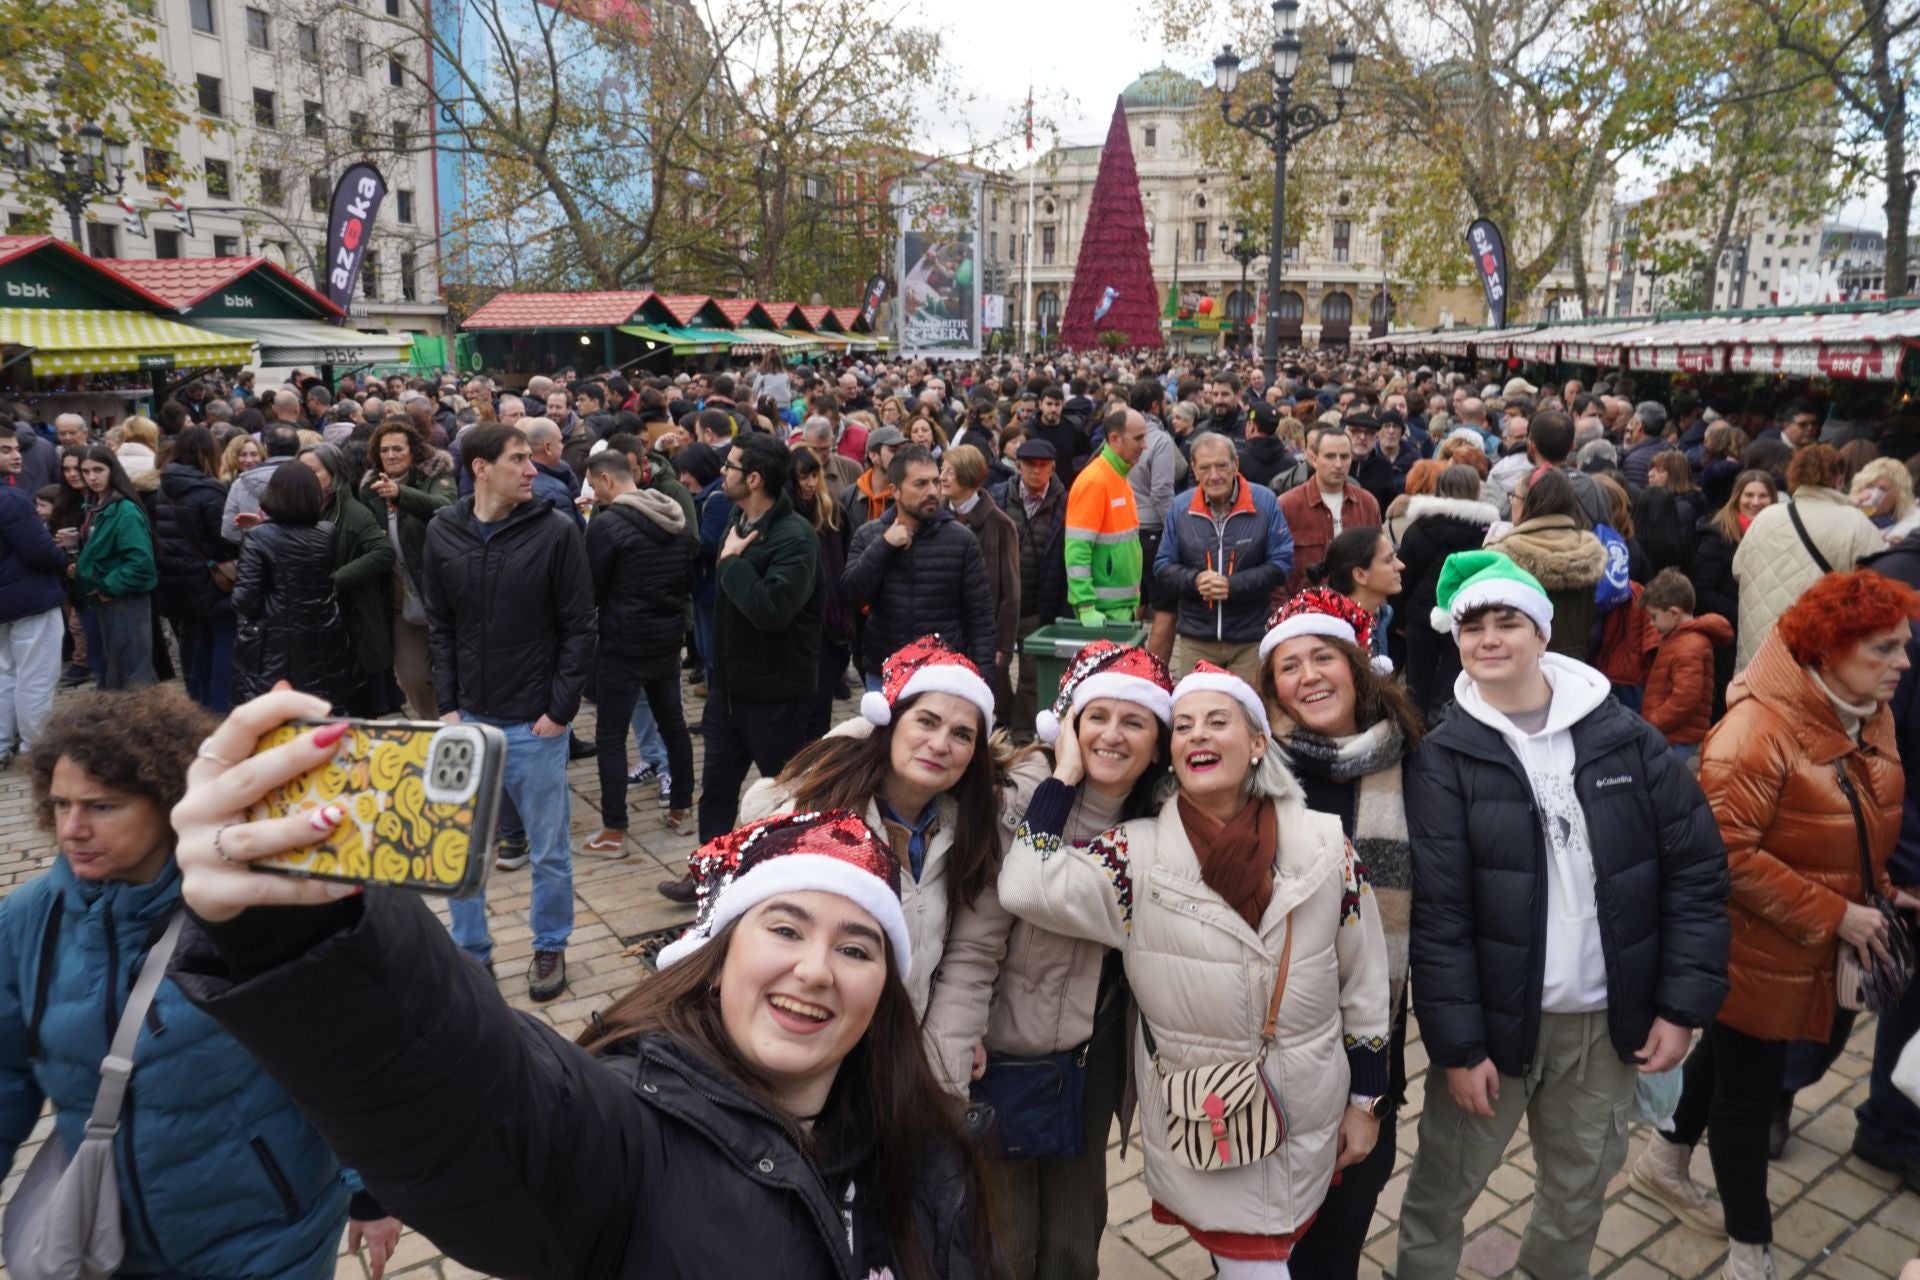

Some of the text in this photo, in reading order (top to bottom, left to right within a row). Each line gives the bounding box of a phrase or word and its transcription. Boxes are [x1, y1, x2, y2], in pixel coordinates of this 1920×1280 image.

[331, 176, 377, 291] azoka
[6, 281, 51, 298] bbk
[1778, 260, 1842, 307] bbk
[223, 294, 254, 308] bbk
[324, 347, 359, 363] bbk
[1602, 775, 1632, 786] Columbia
